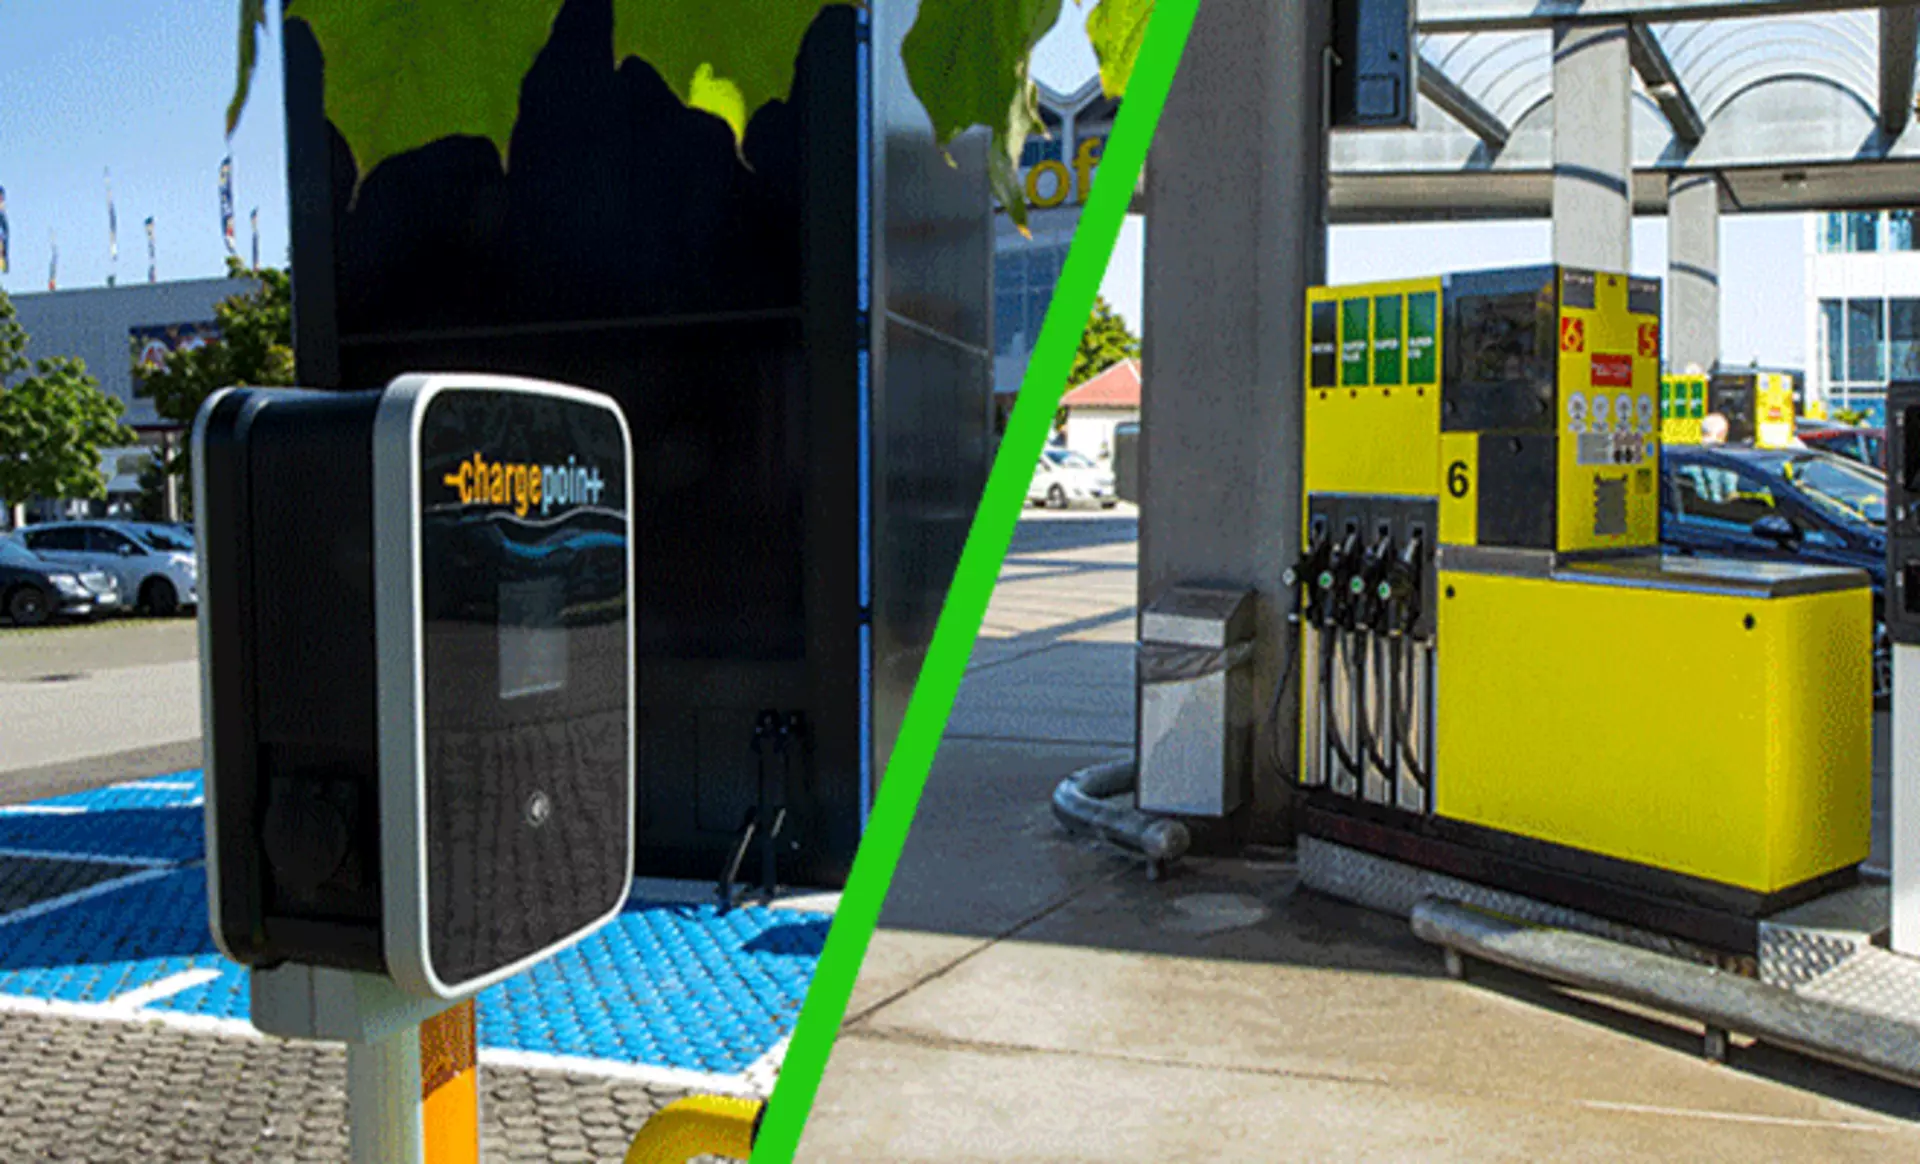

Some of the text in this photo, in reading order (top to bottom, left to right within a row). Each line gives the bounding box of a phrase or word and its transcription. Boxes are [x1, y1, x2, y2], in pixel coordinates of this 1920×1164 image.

[1564, 318, 1582, 352] 6
[1642, 323, 1658, 357] 5
[1447, 460, 1469, 499] 6
